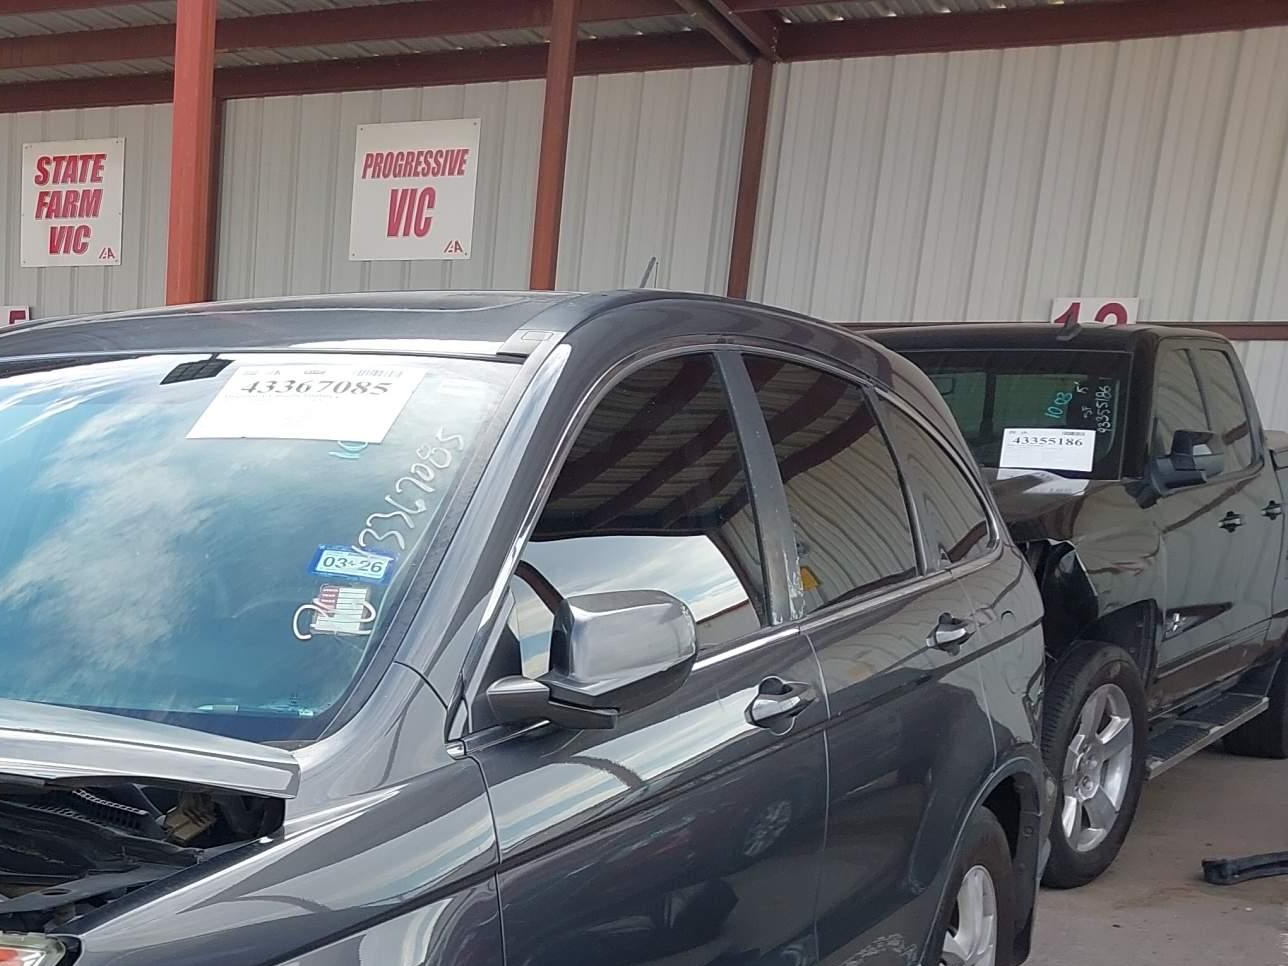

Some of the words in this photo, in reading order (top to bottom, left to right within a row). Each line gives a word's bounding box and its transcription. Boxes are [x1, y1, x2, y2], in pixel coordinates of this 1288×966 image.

[33, 153, 108, 187] STATE
[361, 148, 470, 180] PROGRESSIVE
[34, 188, 104, 221] FARM
[386, 186, 437, 239] VIC
[48, 224, 92, 256] VIC
[240, 379, 393, 396] 43367085
[1012, 436, 1084, 447] 43355186
[322, 556, 349, 569] 03
[356, 560, 384, 574] 26
